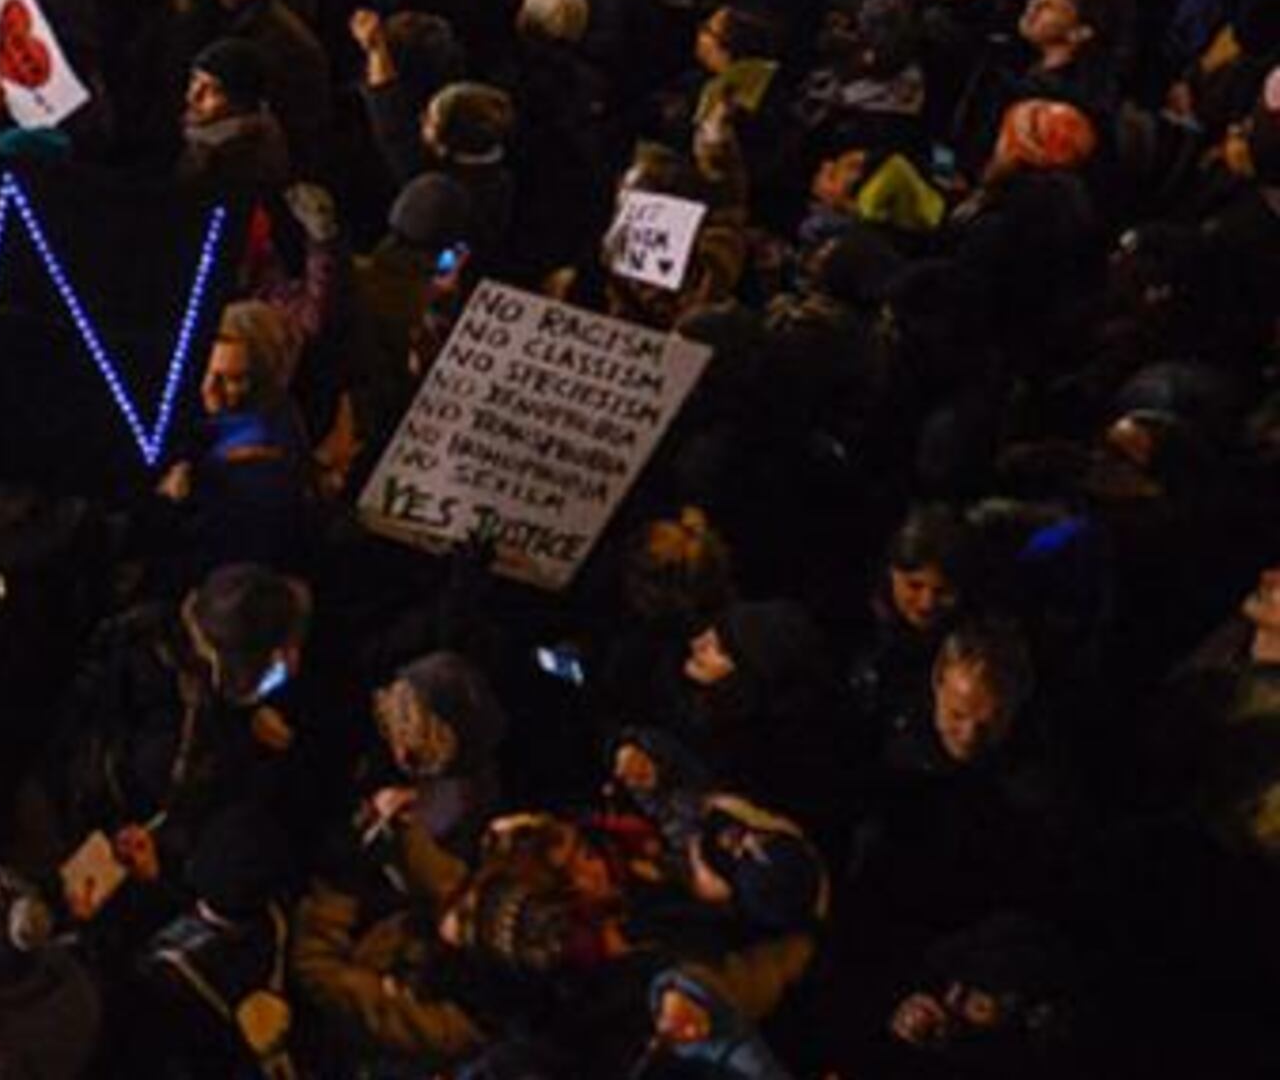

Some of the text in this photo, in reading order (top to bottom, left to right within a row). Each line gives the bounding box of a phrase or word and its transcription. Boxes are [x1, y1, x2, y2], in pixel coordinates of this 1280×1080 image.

[458, 319, 666, 396] NO CLASSISM
[470, 288, 665, 368] NO RACISM
[414, 392, 464, 423] NO
[431, 367, 476, 399] NO
[446, 343, 662, 429] NO SPECIESISM
[404, 419, 443, 448] NO
[394, 440, 568, 516] NO SEXISM
[379, 474, 590, 563] YES JUSTICE
